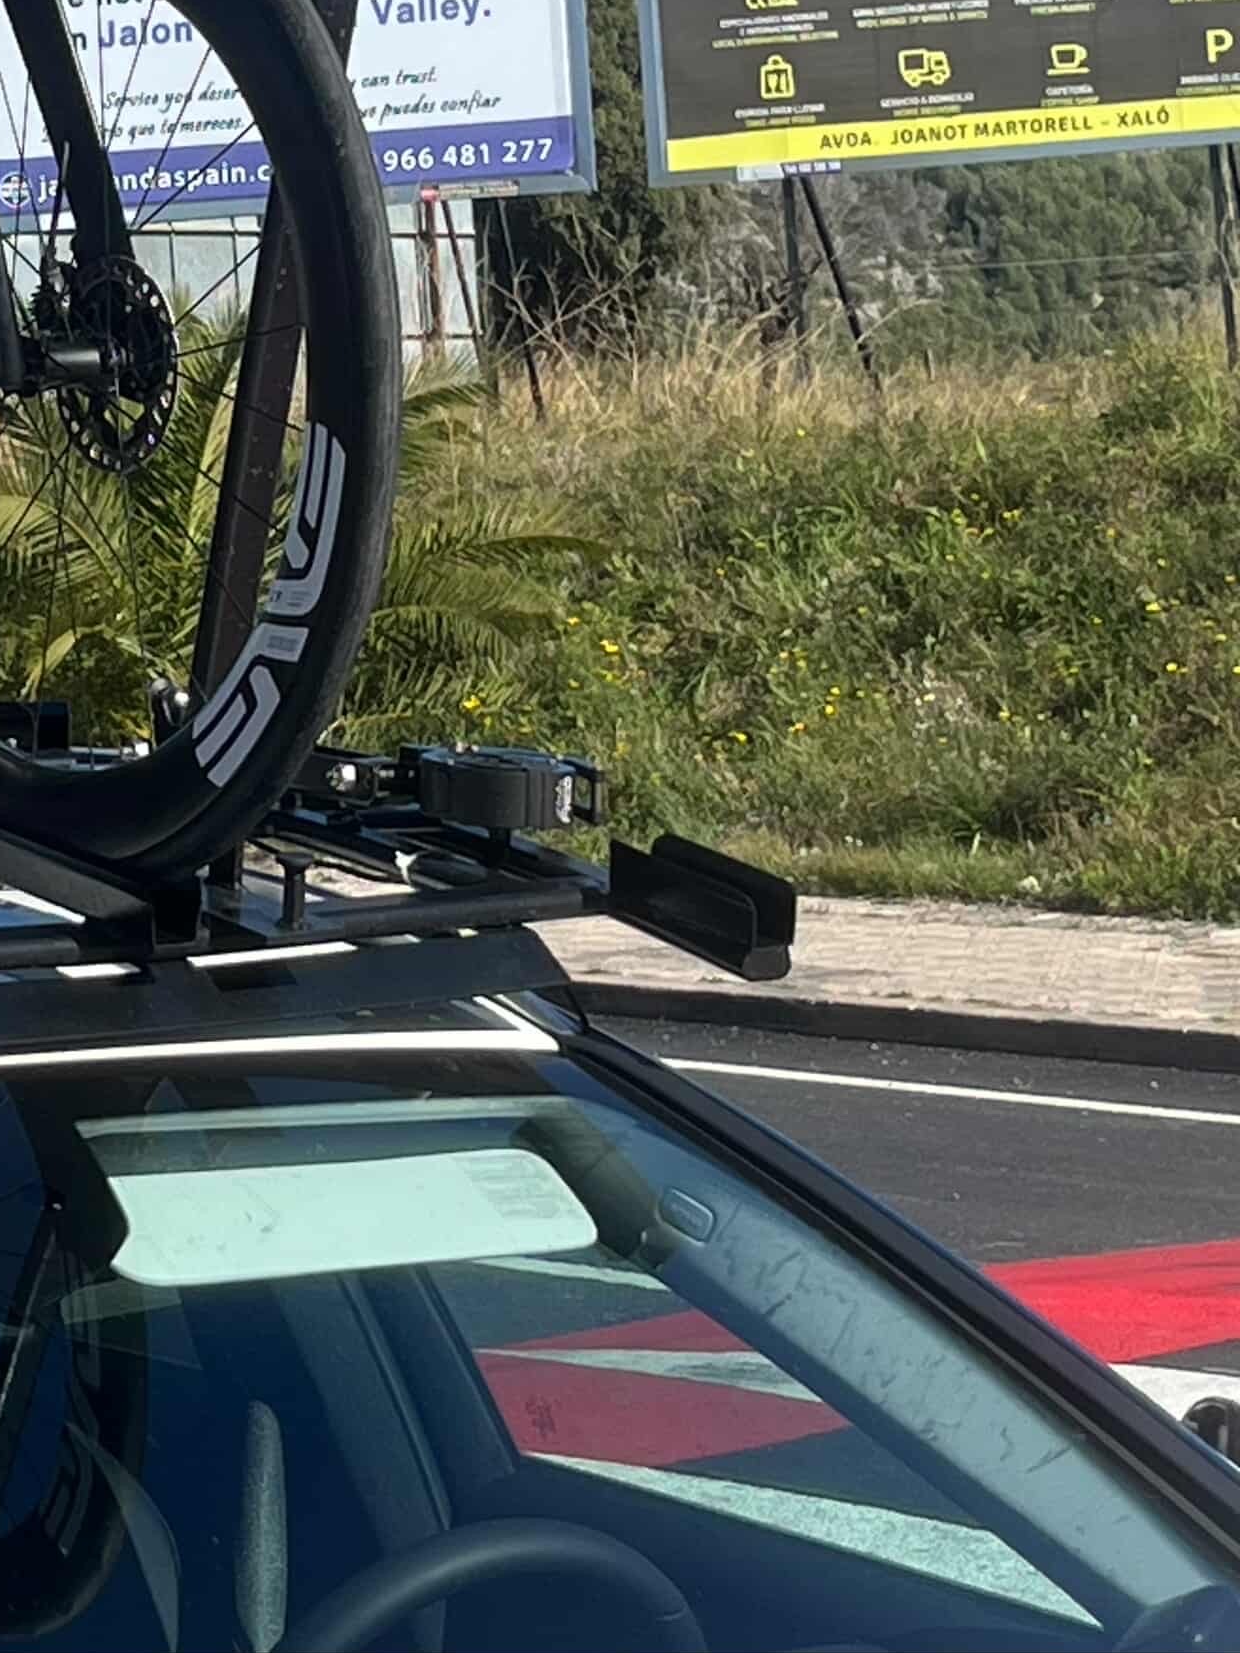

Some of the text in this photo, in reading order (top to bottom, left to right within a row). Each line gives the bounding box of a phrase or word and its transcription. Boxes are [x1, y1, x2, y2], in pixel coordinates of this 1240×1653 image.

[99, 17, 193, 49] Jalon
[361, 75, 390, 90] can
[378, 92, 437, 126] puedes
[440, 89, 502, 115] confiar
[890, 123, 968, 147] JOANOT
[974, 114, 1093, 141] MARTORELL
[1116, 106, 1170, 129] XALÓ
[382, 145, 434, 172] 966
[441, 142, 491, 167] 481
[501, 137, 553, 164] 277
